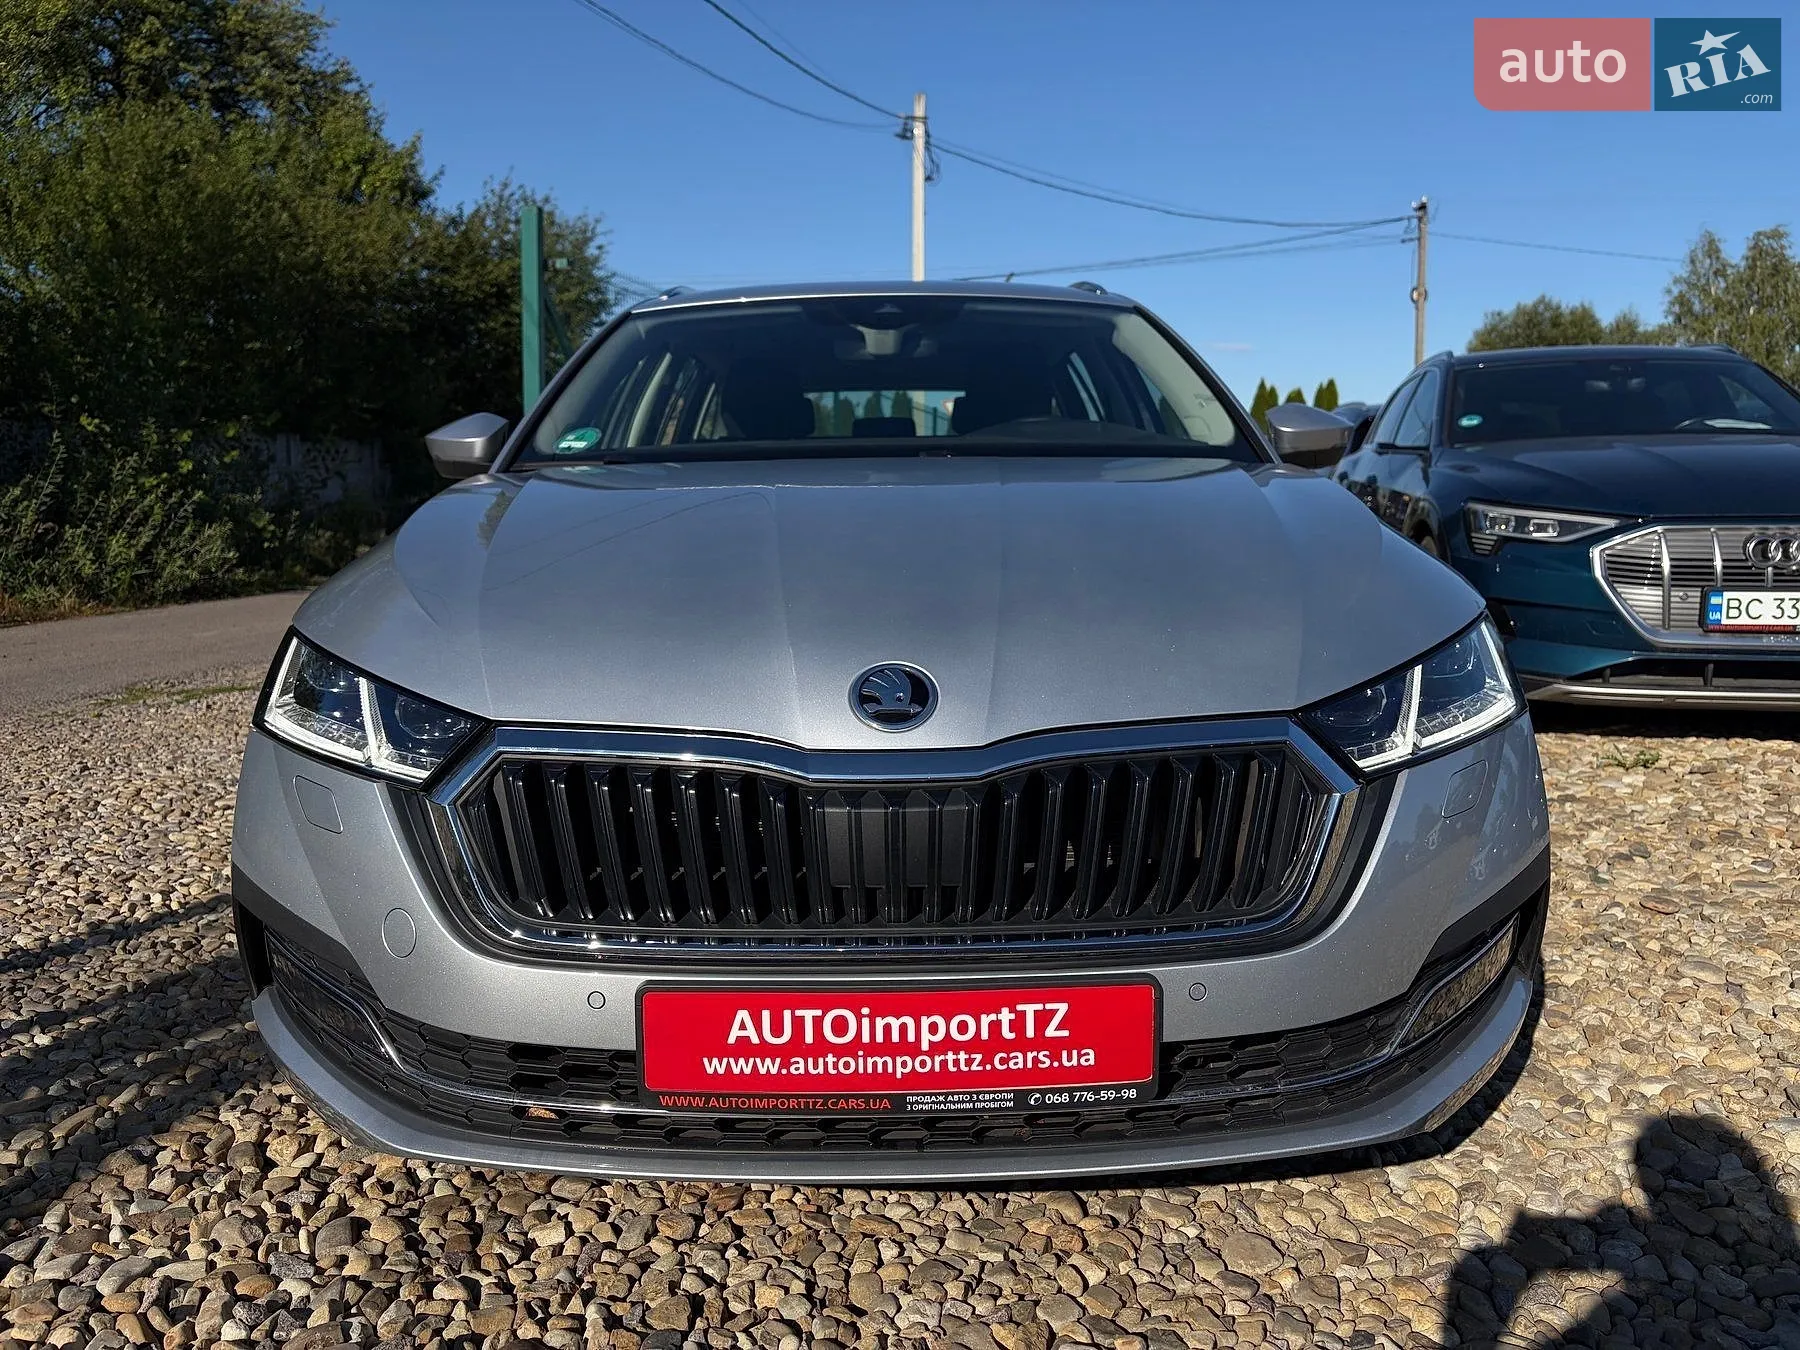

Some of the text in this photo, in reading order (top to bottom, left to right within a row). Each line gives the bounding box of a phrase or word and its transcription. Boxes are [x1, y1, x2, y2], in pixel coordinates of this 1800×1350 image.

[1709, 611, 1721, 620] UA
[1726, 598, 1763, 620] BC
[727, 1002, 1070, 1052] AUTOimportTZ
[702, 1048, 1096, 1080] www.autoimporttz.cars.ua
[659, 1095, 892, 1110] WWW.AUTOIMPORTTZ.CARS.UA
[906, 1095, 946, 1104] ПРОДАЖ
[948, 1094, 970, 1103] АВТО
[979, 1092, 1014, 1101] ЄВРОПИ
[1044, 1088, 1138, 1104] 068 776-59-98
[912, 1102, 974, 1111] ОРИГІНАЛЬНИМ
[975, 1101, 1014, 1110] ПРОБІГОМ
